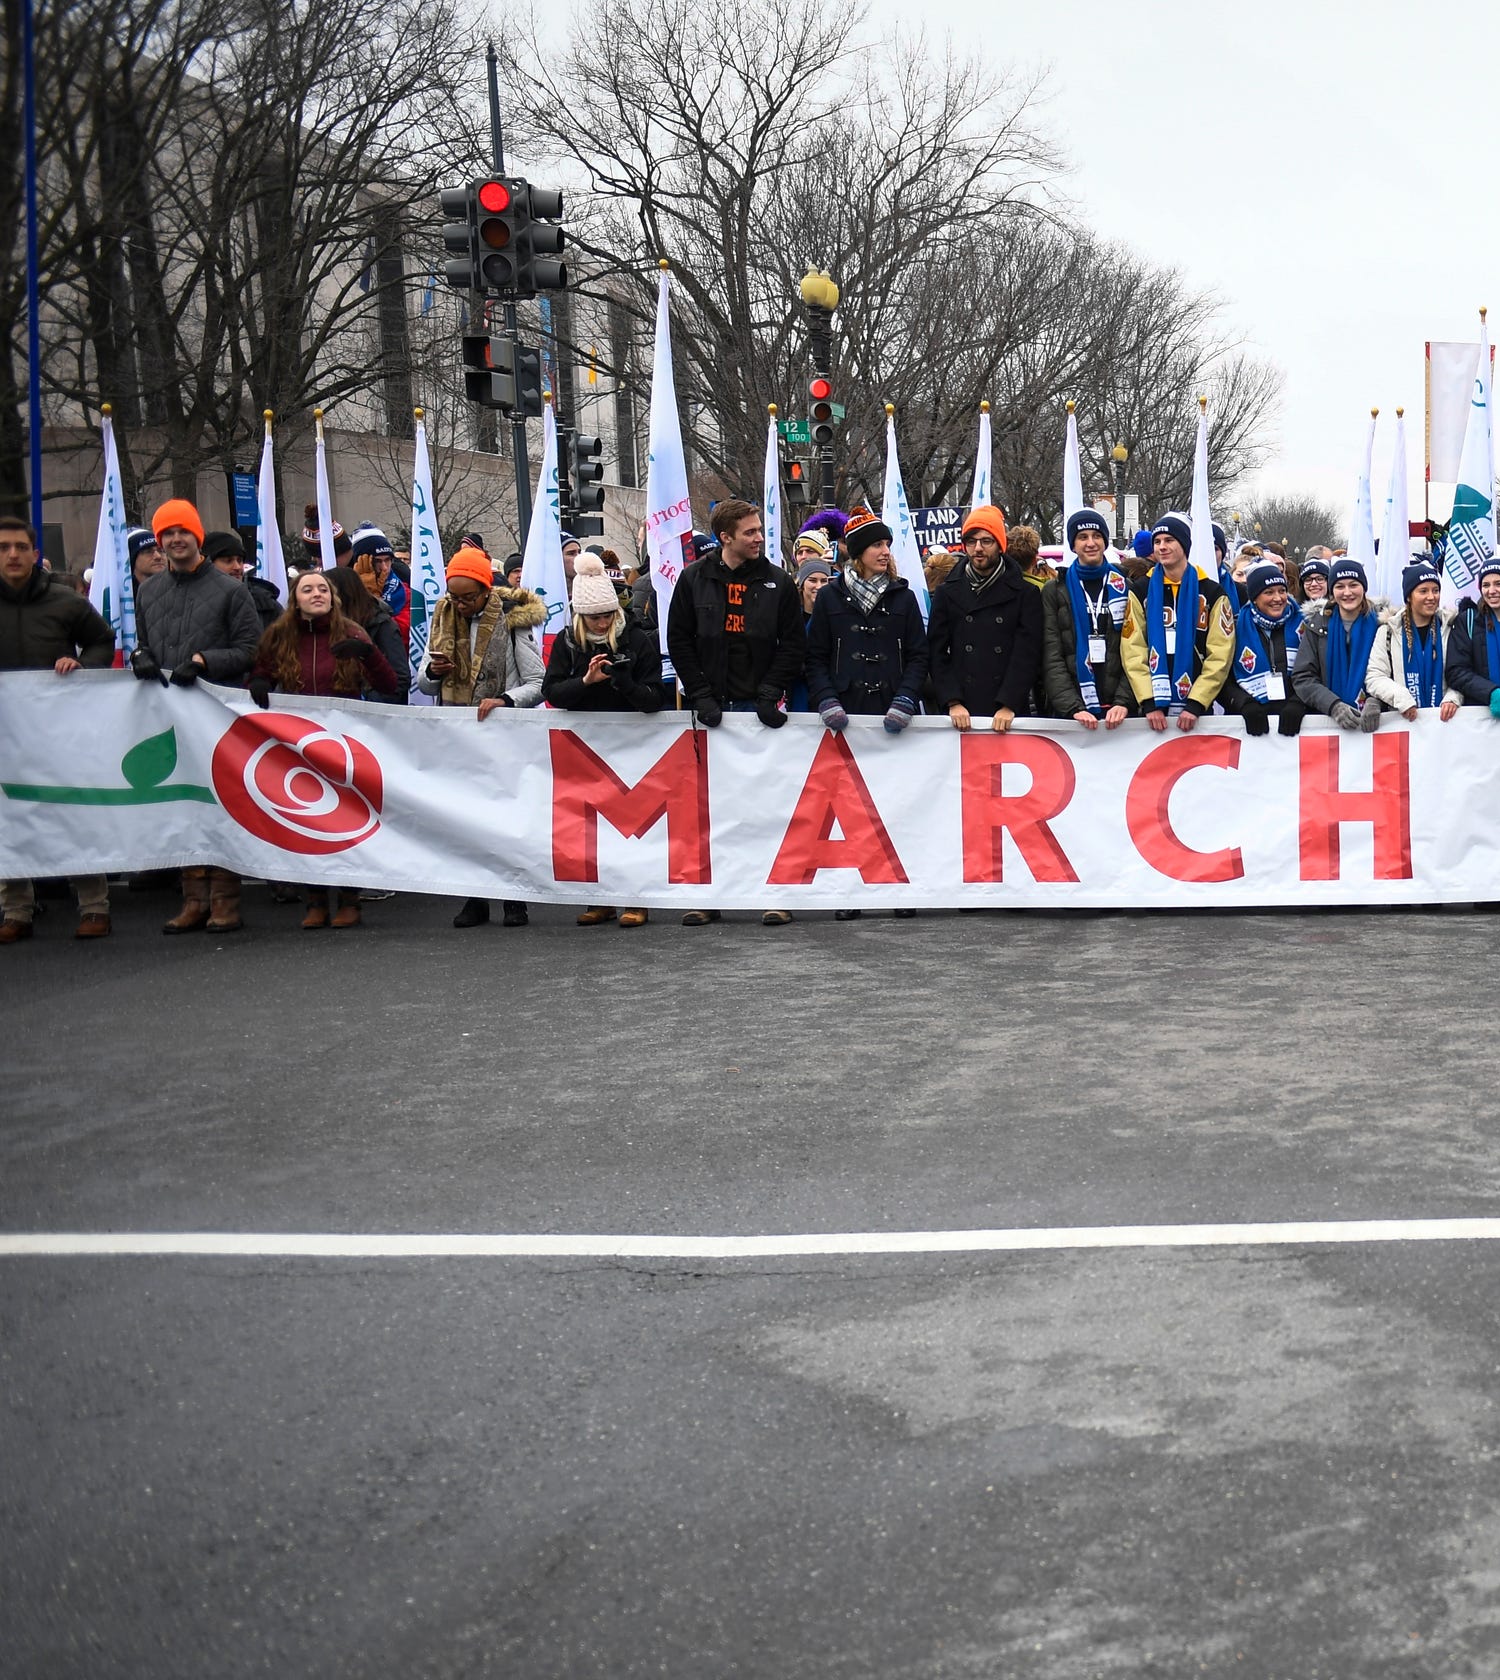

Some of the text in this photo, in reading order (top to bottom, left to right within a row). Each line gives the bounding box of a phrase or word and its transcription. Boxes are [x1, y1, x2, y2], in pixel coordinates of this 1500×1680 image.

[783, 422, 799, 433] 12
[791, 433, 806, 441] 100
[926, 508, 960, 526] AND
[1336, 570, 1359, 578] SAINTS
[549, 728, 1413, 885] MARCH
